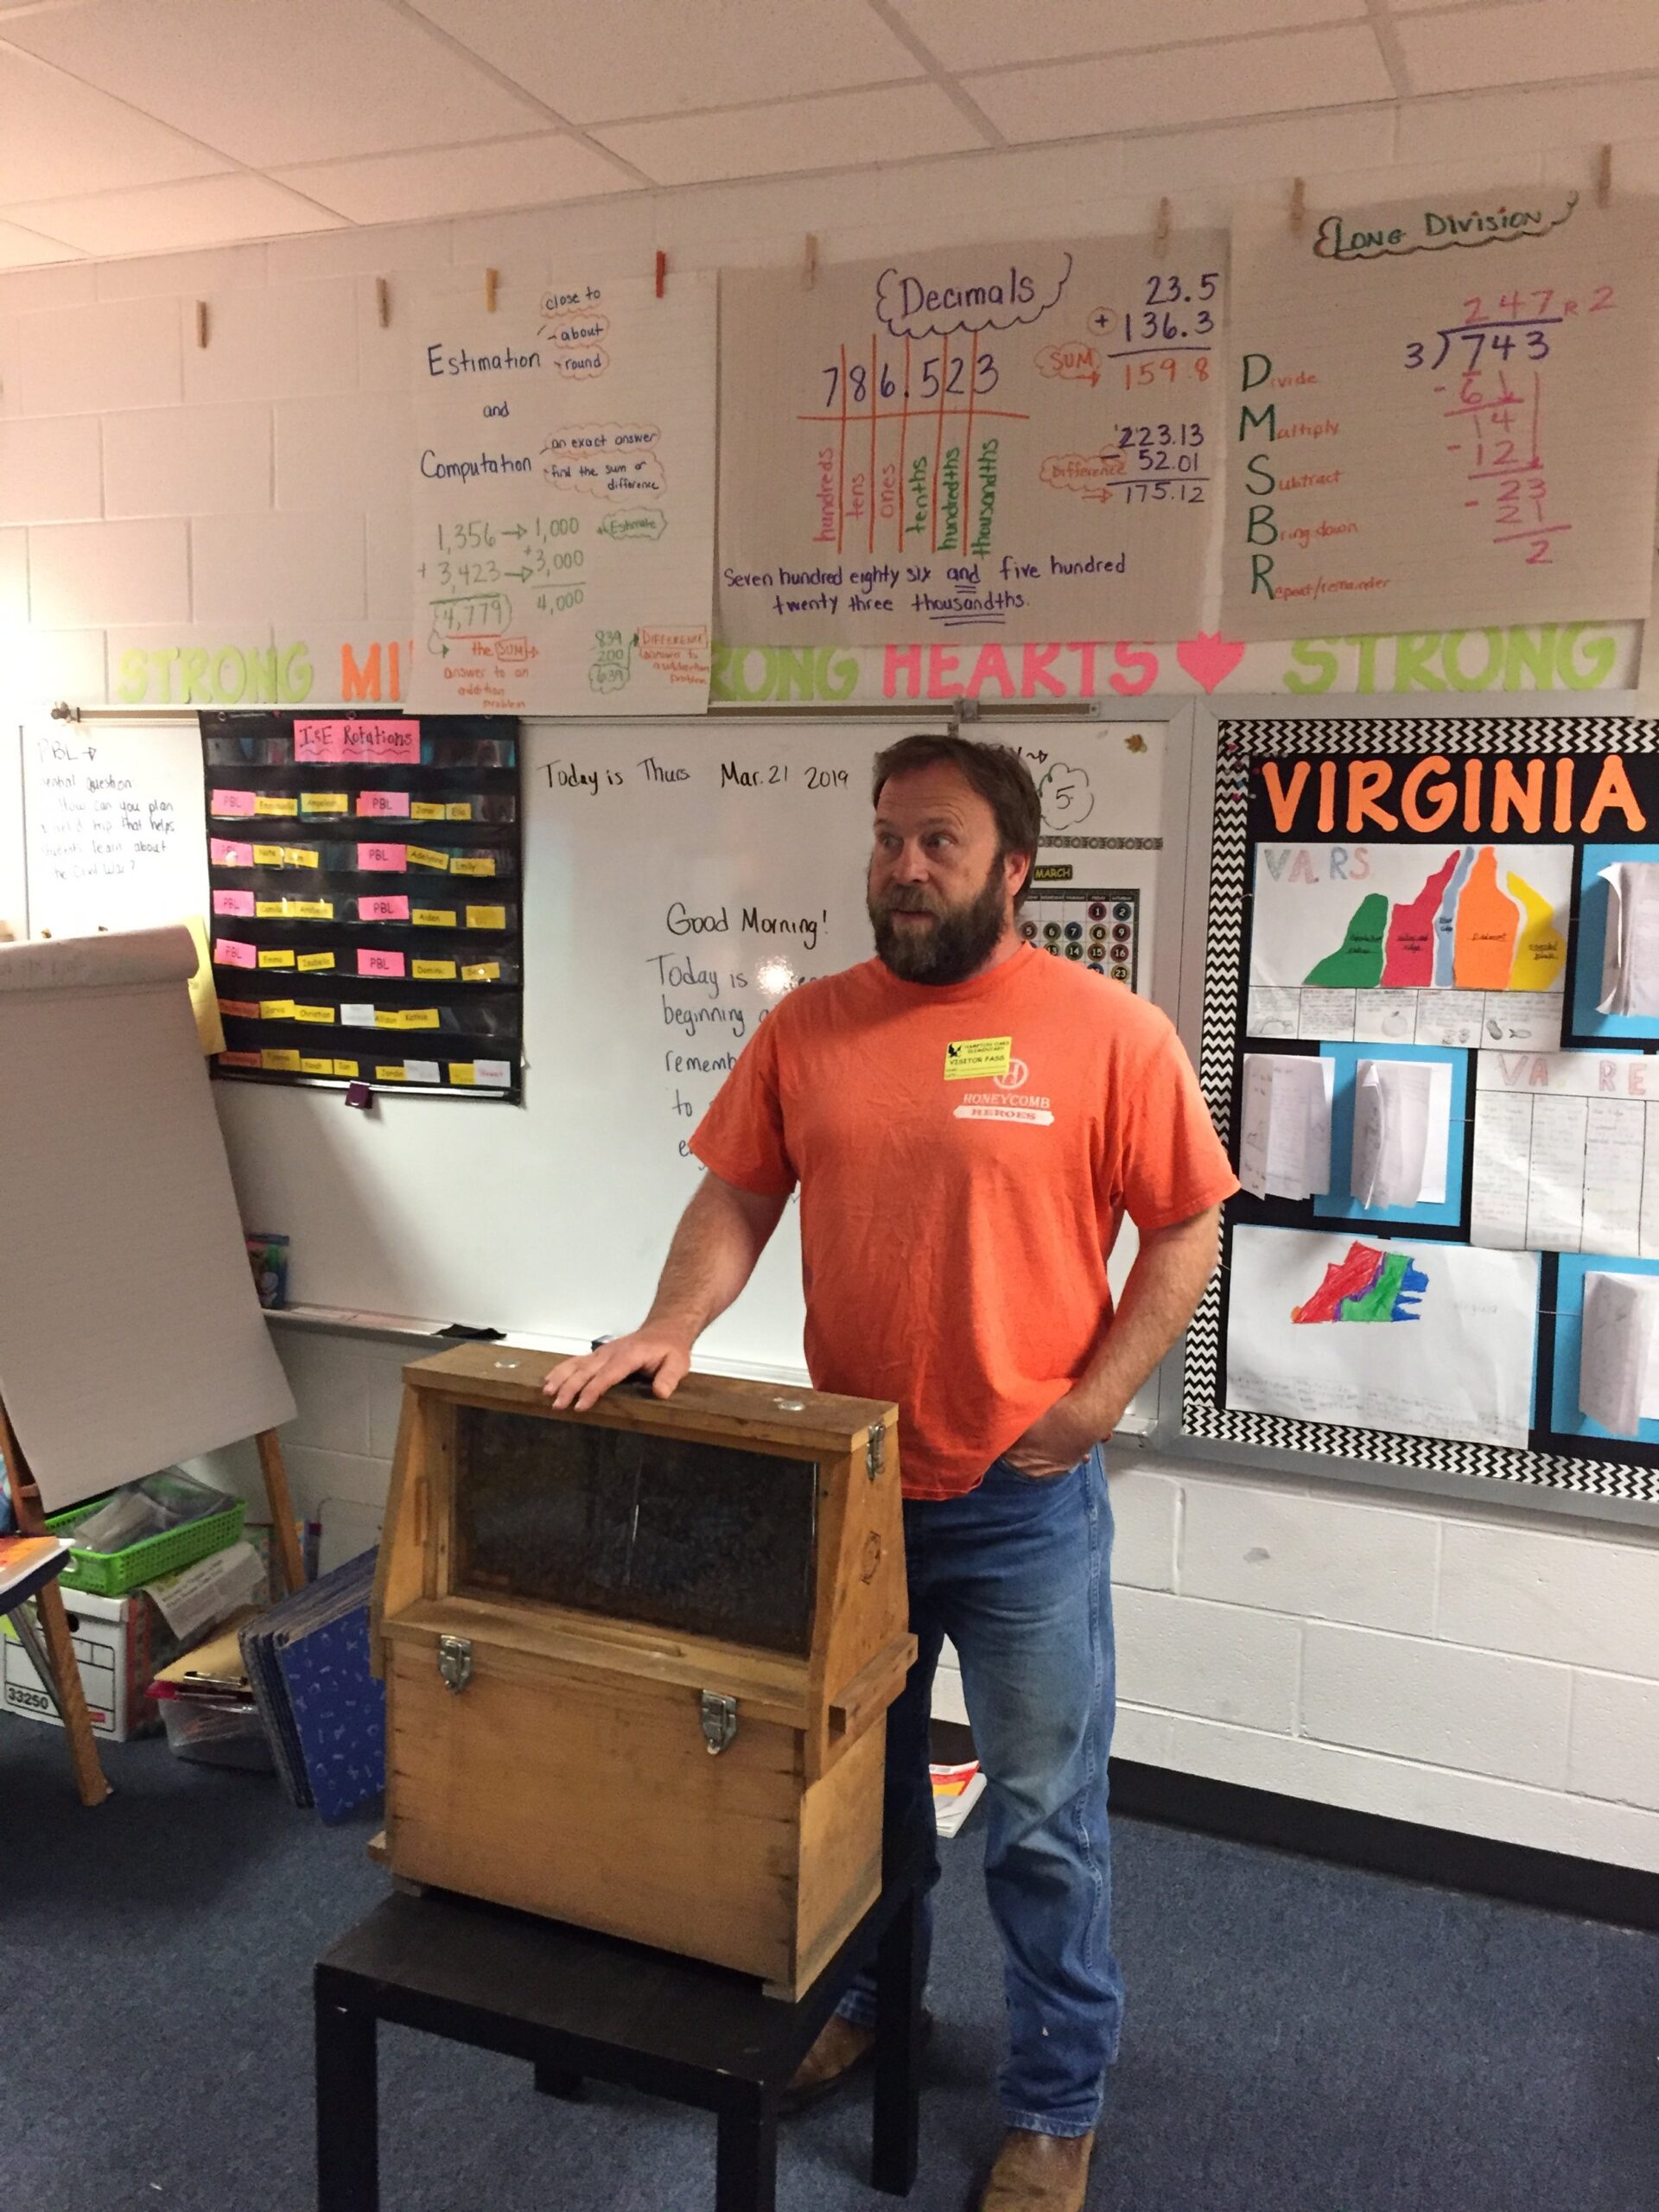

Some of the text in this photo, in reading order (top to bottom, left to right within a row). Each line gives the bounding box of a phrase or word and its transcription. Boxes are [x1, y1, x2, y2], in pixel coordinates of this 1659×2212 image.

[545, 286, 601, 310] close to
[899, 266, 1035, 318] Decimals
[1147, 272, 1218, 305] 23.5
[1464, 289, 1553, 325] 247
[1589, 286, 1618, 313] 2
[561, 322, 604, 340] about
[1125, 310, 1215, 342] 136.3
[427, 343, 541, 377] Estimation
[565, 353, 602, 371] round
[1049, 349, 1093, 372] SUM
[1461, 331, 1550, 370] 743
[483, 401, 510, 418] and
[551, 432, 658, 449] an exact answer
[421, 448, 532, 484] Computation
[579, 463, 599, 477] the
[606, 462, 627, 474] sum
[635, 461, 647, 472] or
[1138, 449, 1198, 473] 52.01
[812, 447, 836, 543] hundreds
[846, 473, 864, 518] tens
[880, 464, 896, 518] ones
[905, 456, 927, 533] tenths
[938, 447, 960, 551] hundredths
[971, 438, 999, 560] thousandths
[438, 517, 580, 555] 1,356 1,000
[535, 550, 585, 578] 3,000
[1525, 540, 1554, 564] 2
[437, 560, 502, 594] 3,423
[779, 567, 842, 587] hundred
[849, 568, 899, 594] eighty
[906, 566, 932, 585] six
[946, 563, 980, 585] and
[1000, 556, 1041, 579] five
[1050, 552, 1126, 576] hundred
[536, 589, 585, 615] 4,000
[773, 594, 838, 614] twenty
[849, 594, 893, 611] three
[442, 599, 504, 632] 4,779
[473, 641, 495, 656] the
[882, 640, 1160, 700] HEARTS
[1282, 620, 1618, 696] STRONG
[118, 638, 415, 704] STRONG MI
[443, 664, 529, 679] answer to an
[343, 724, 413, 747] Rotations
[536, 759, 599, 797] Today
[606, 768, 624, 787] is
[768, 766, 788, 785] 21
[804, 766, 849, 790] 2019
[372, 797, 393, 810] PBL
[1055, 785, 1076, 810] 5
[1261, 753, 1648, 835] VIRGINIA
[369, 849, 389, 861] PBL
[1035, 867, 1071, 880] MARCH
[373, 903, 394, 914] PBL
[1119, 907, 1127, 918] 2
[666, 901, 830, 950] Good Morning!
[1026, 926, 1126, 938] 5 6 7 8 9
[370, 957, 390, 970] PBL
[1069, 946, 1080, 957] 14
[1091, 948, 1103, 957] 15
[1115, 949, 1127, 958] 16
[645, 951, 720, 1000] Today
[729, 971, 748, 989] is
[1115, 969, 1127, 979] 23
[662, 994, 746, 1038] beginning
[665, 1050, 737, 1073] rememb
[950, 1054, 1006, 1066] VISITOR PASS
[672, 1089, 693, 1118] to
[963, 1092, 1052, 1109] HONEYCOMB
[971, 1108, 1036, 1121] HEROES
[9, 1688, 49, 1710] 33250
